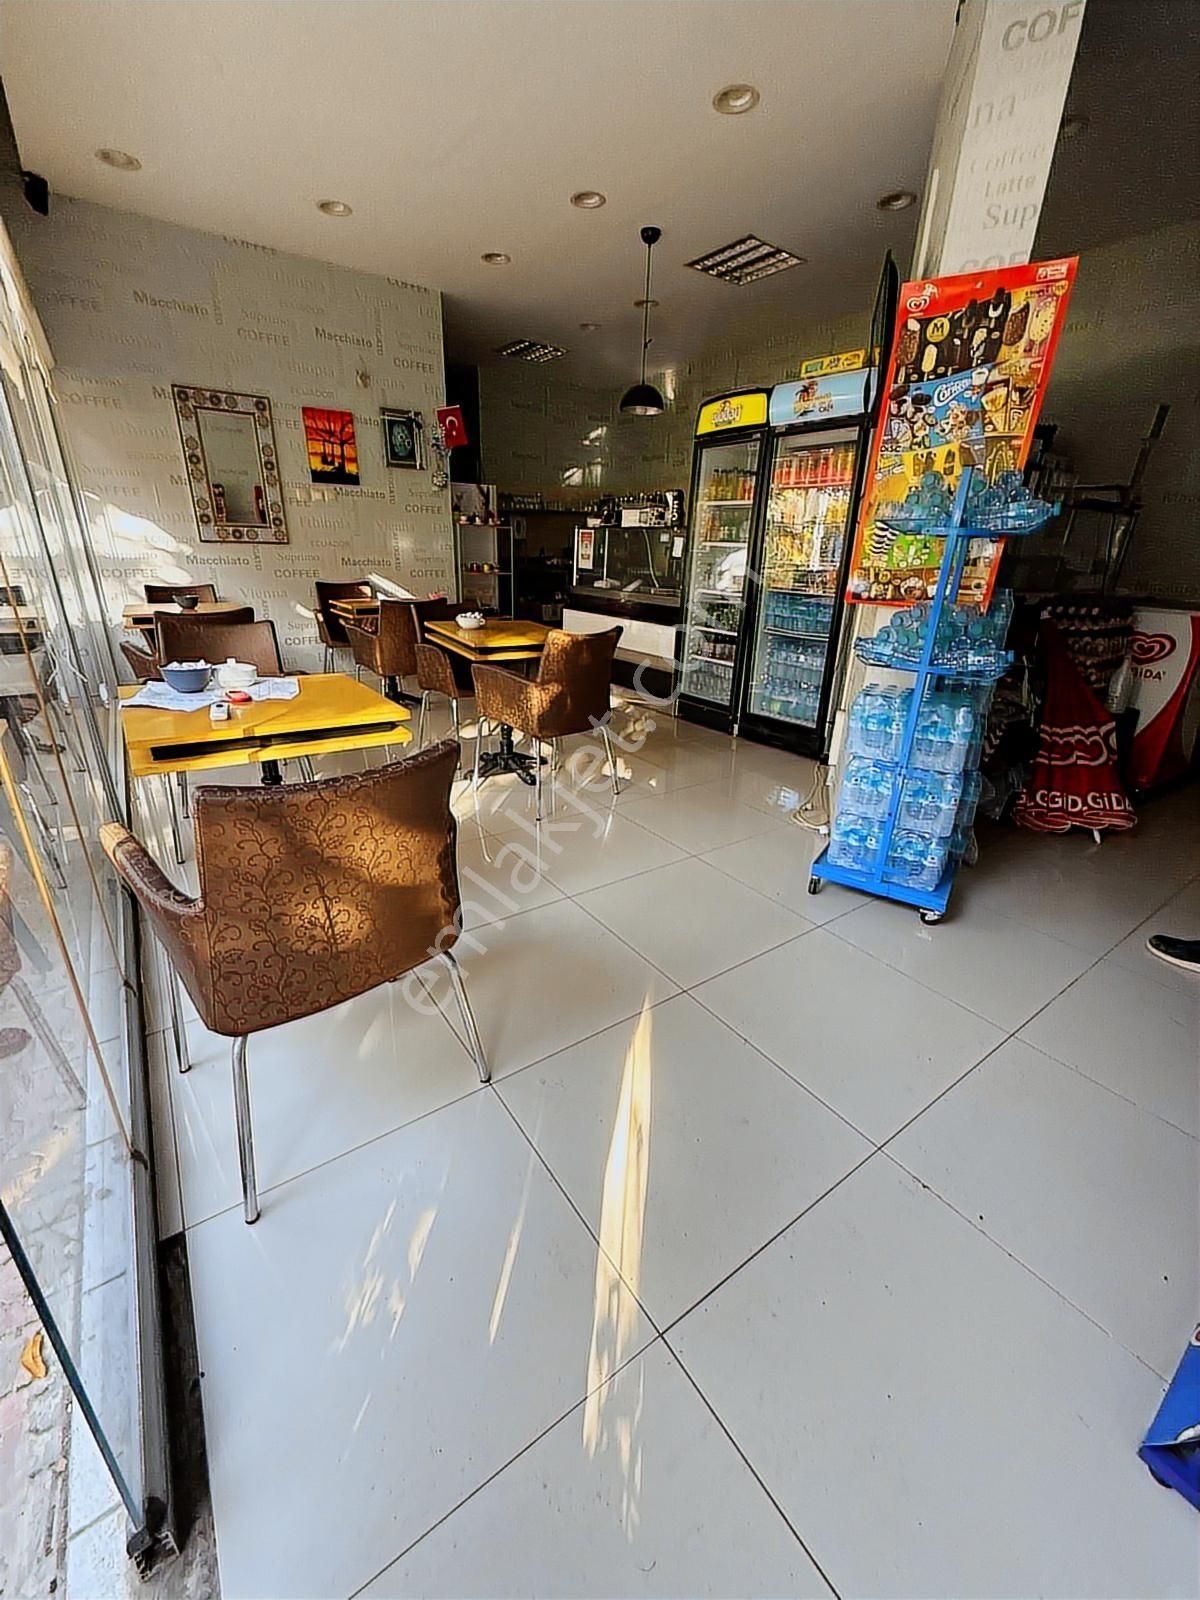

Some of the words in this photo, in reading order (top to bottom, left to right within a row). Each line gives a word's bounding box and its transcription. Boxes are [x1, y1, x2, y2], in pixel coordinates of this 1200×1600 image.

[132, 289, 209, 317] Macchiato
[237, 327, 290, 347] COFFEE
[314, 326, 373, 349] Macchiato
[393, 357, 435, 374] COFFEE
[404, 503, 442, 515] COFFEE
[186, 554, 250, 566] Macchiato
[341, 557, 392, 568] Macchiato
[102, 568, 160, 579] COFFEE
[274, 569, 320, 578] COFFEE
[410, 569, 446, 578] COFFEE
